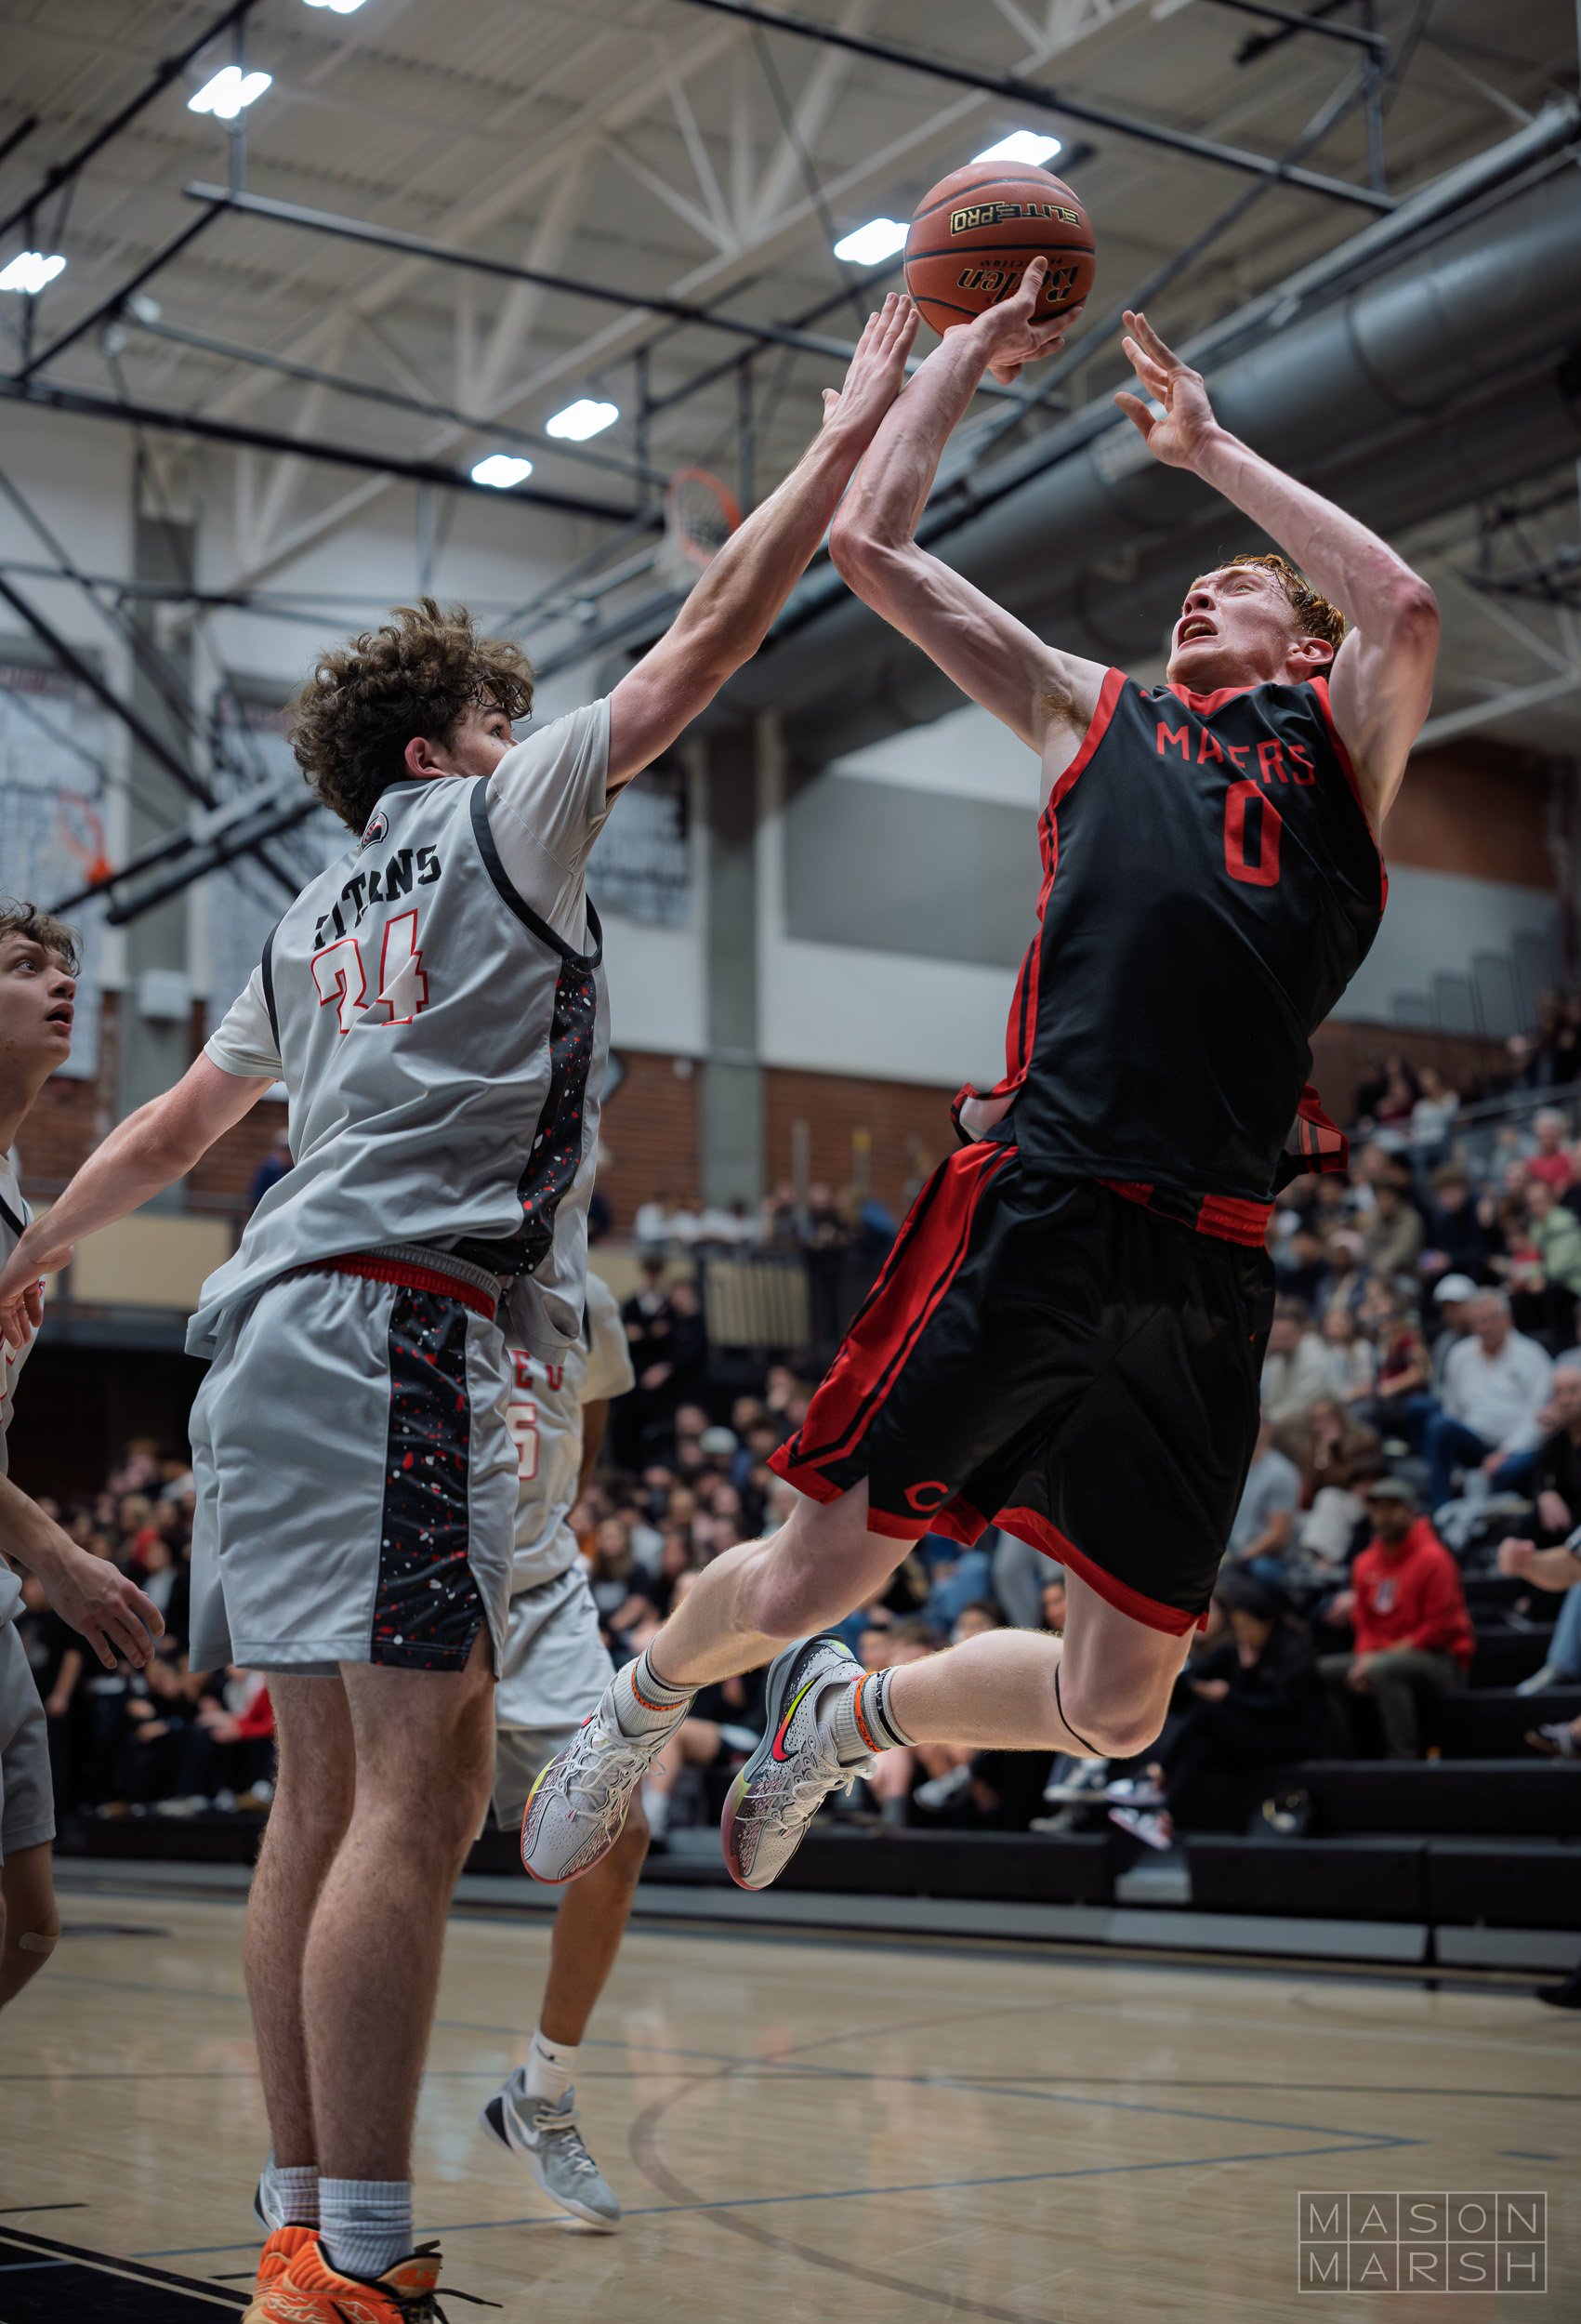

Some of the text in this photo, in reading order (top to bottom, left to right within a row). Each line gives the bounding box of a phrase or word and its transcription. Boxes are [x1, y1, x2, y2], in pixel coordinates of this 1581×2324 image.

[954, 203, 1081, 231] ELITE PRO
[957, 266, 1079, 303] Bden
[1224, 779, 1283, 887] 0
